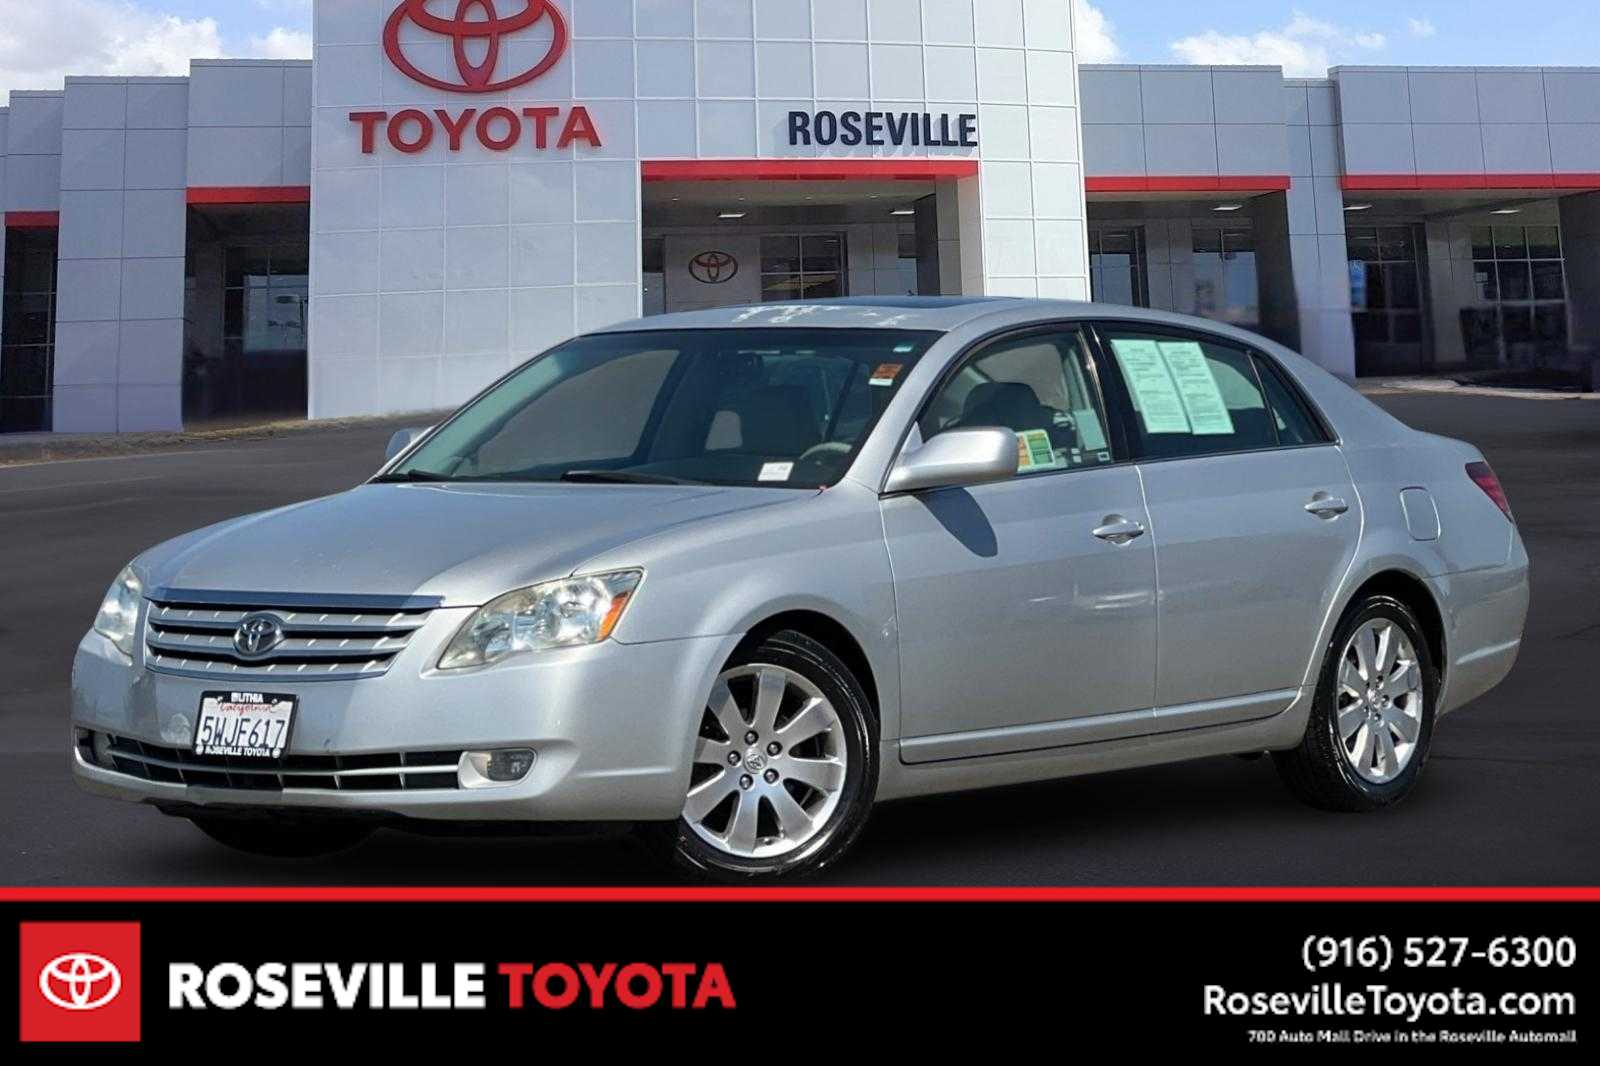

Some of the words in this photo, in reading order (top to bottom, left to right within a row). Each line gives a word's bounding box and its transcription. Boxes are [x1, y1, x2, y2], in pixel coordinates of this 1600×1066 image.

[349, 105, 602, 154] TOYOTA
[788, 110, 978, 147] ROSEVILLE
[201, 716, 285, 748] 5WJF617
